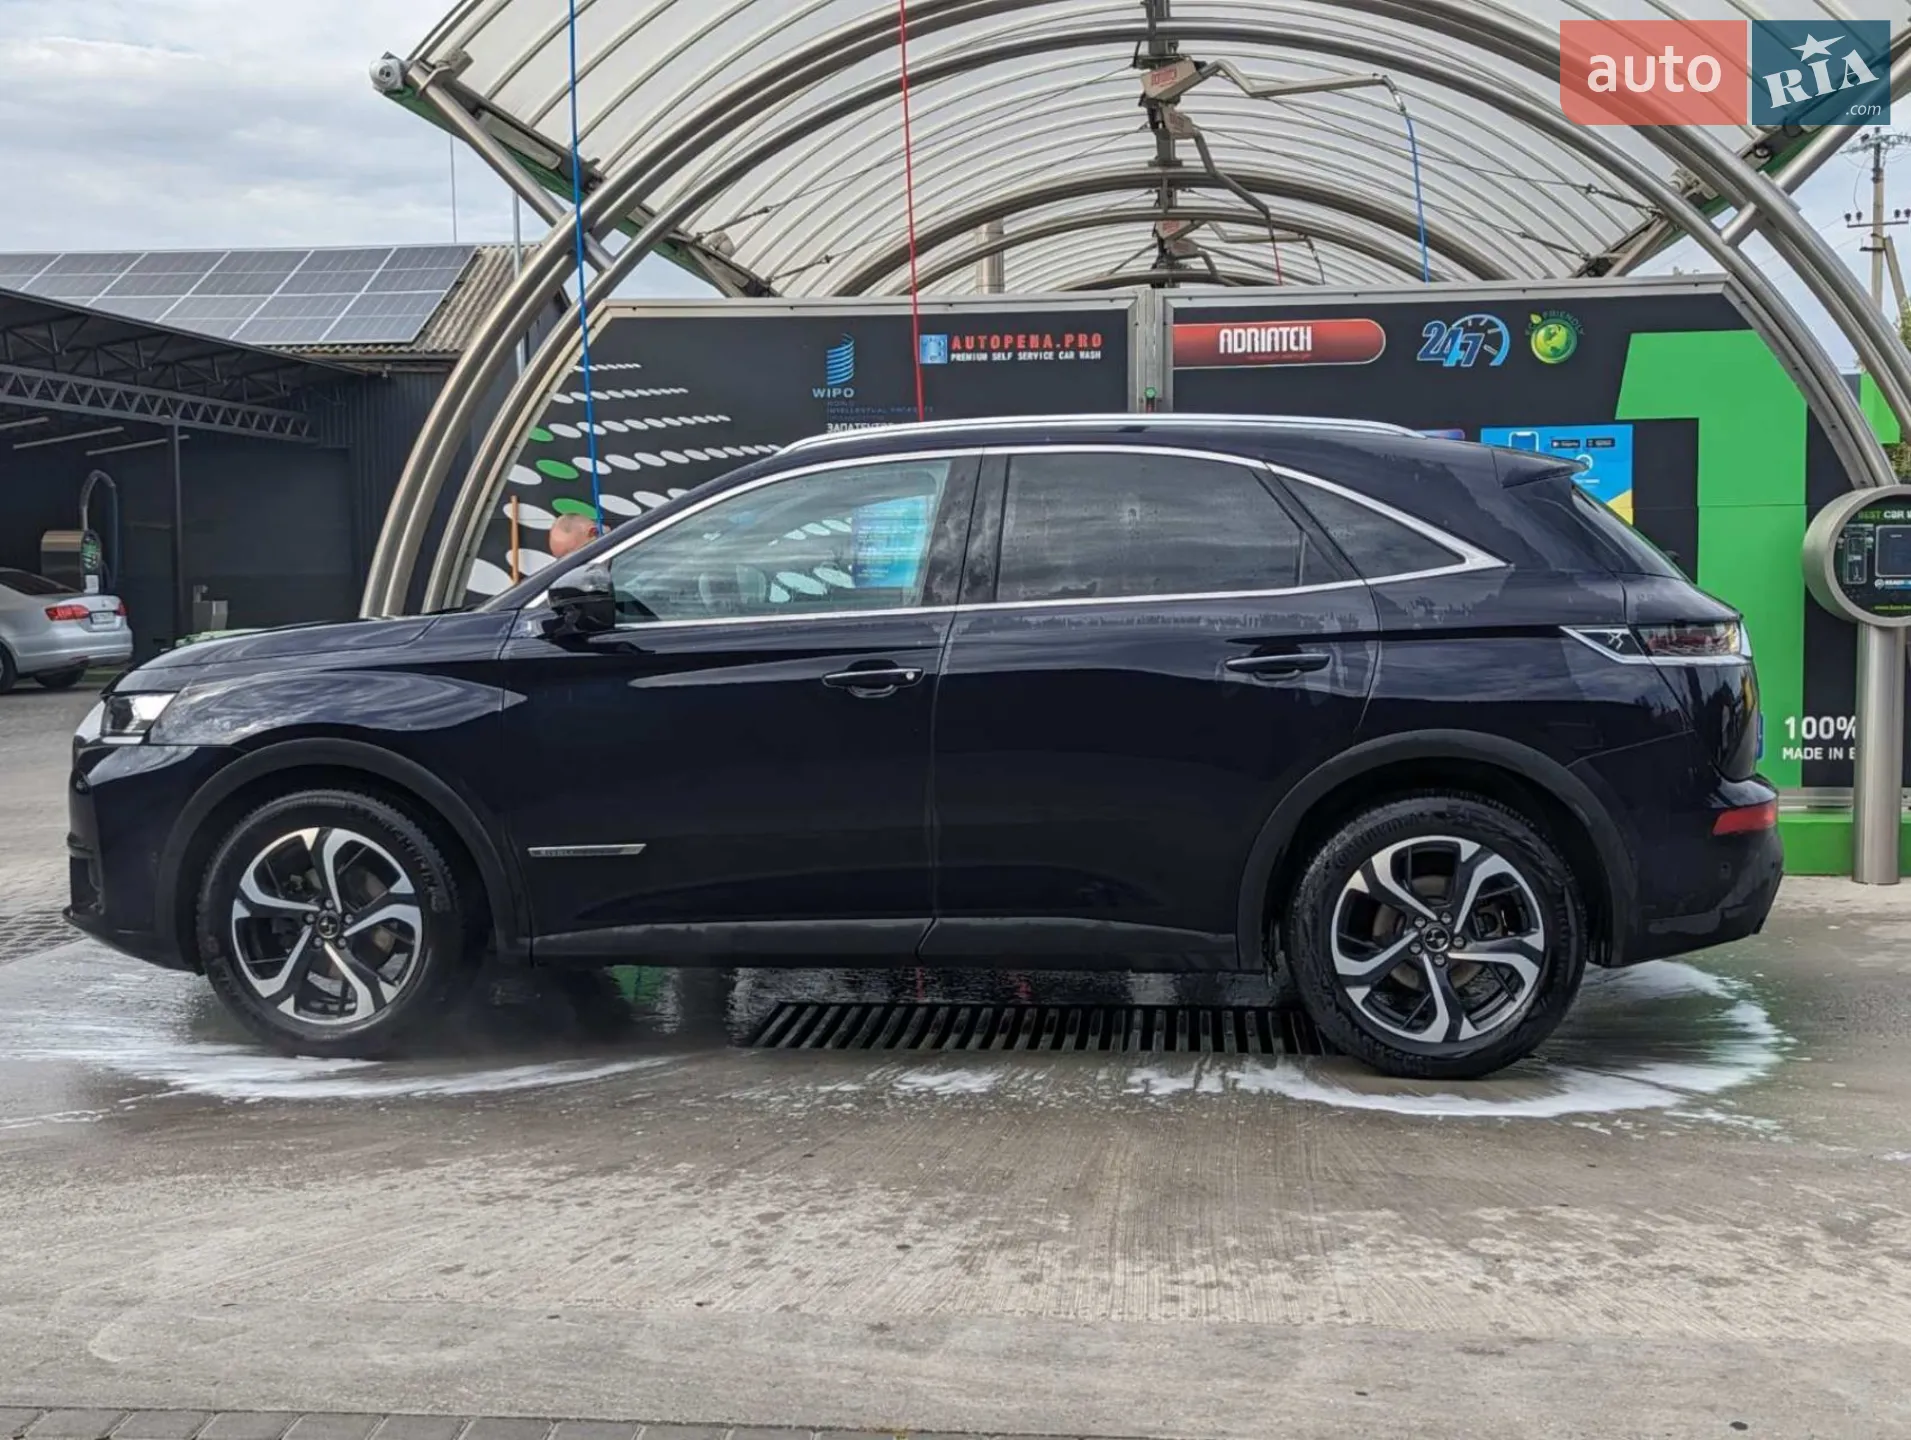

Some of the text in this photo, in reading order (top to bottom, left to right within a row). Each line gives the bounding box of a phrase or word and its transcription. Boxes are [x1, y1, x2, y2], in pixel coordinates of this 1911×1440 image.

[950, 350, 1102, 362] PREMIUM SELF SERVICE CAR WASH
[812, 387, 855, 398] WIPO
[1784, 715, 1856, 740] 100%
[1782, 747, 1823, 760] MADE
[1829, 747, 1843, 760] IN
